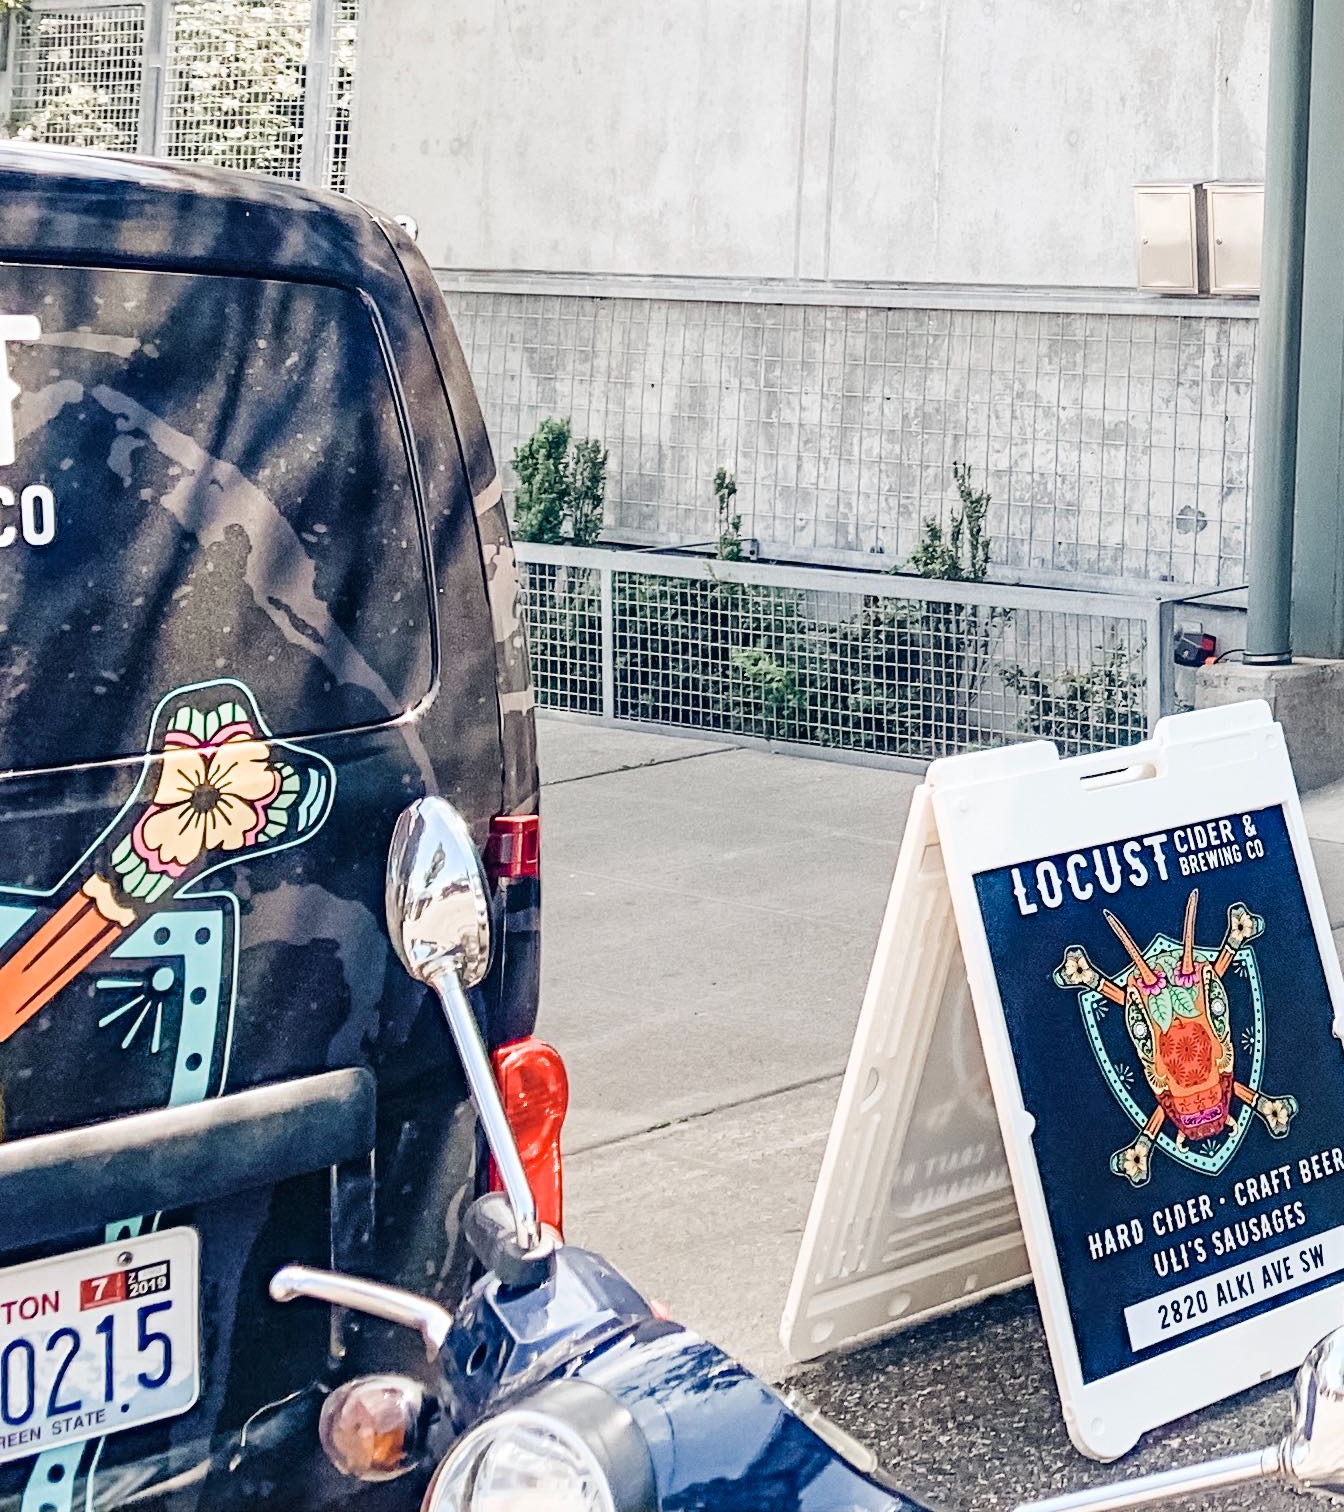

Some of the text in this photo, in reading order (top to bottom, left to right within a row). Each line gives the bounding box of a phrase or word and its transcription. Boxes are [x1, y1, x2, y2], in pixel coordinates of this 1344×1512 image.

[1011, 815, 1258, 916] LOCUST CIDER &
[1179, 838, 1265, 876] BREWING CO
[1088, 1219, 1144, 1260] HARD
[1152, 1194, 1213, 1236] CIDER
[1234, 1165, 1292, 1206] CRAFT
[1153, 1201, 1306, 1277] ULI'S SAUSAGES
[1, 1290, 60, 1325] TON
[91, 1277, 109, 1302] 7
[129, 1275, 167, 1298] 2019
[1157, 1243, 1325, 1330] 2820 ALKI AVE SW
[1, 1300, 173, 1426] 0215
[51, 1408, 107, 1436] STATE
